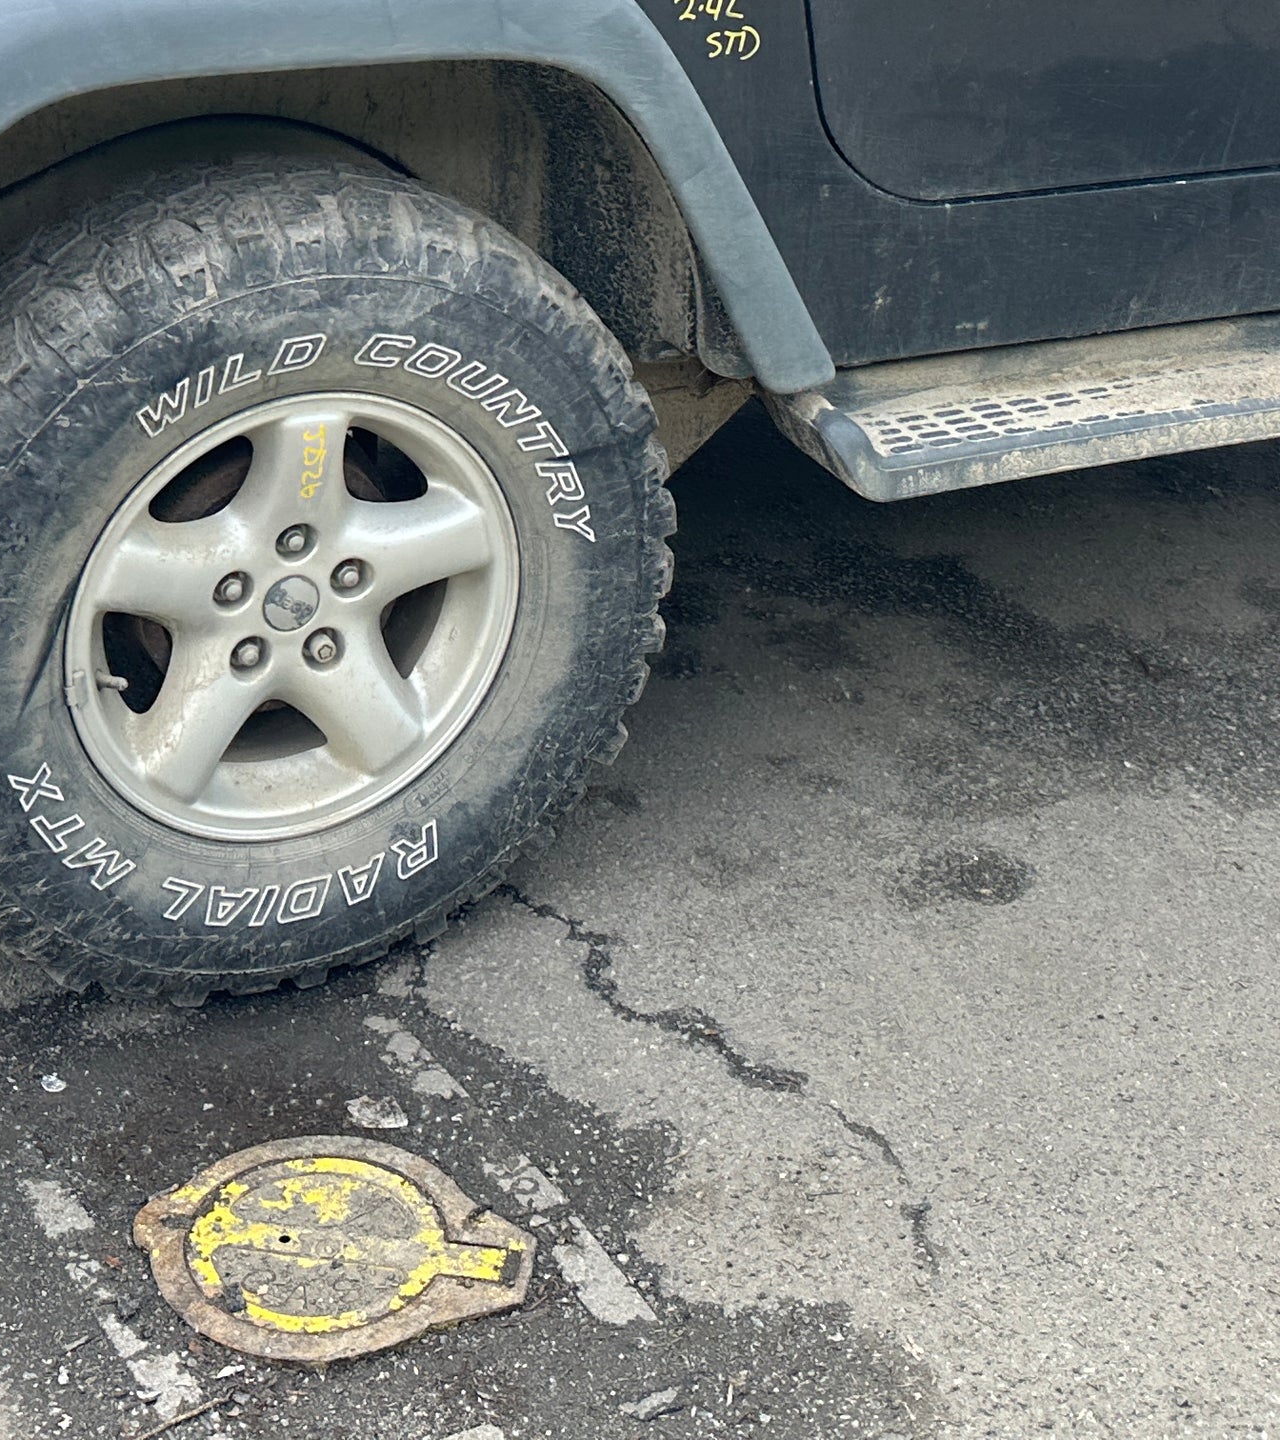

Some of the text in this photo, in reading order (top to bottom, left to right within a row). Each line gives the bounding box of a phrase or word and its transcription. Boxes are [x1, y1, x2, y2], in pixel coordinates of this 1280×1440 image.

[706, 25, 761, 61] STD
[134, 333, 597, 544] WILD COUNTRY
[7, 762, 137, 890] MTX
[161, 818, 442, 929] RADIAL
